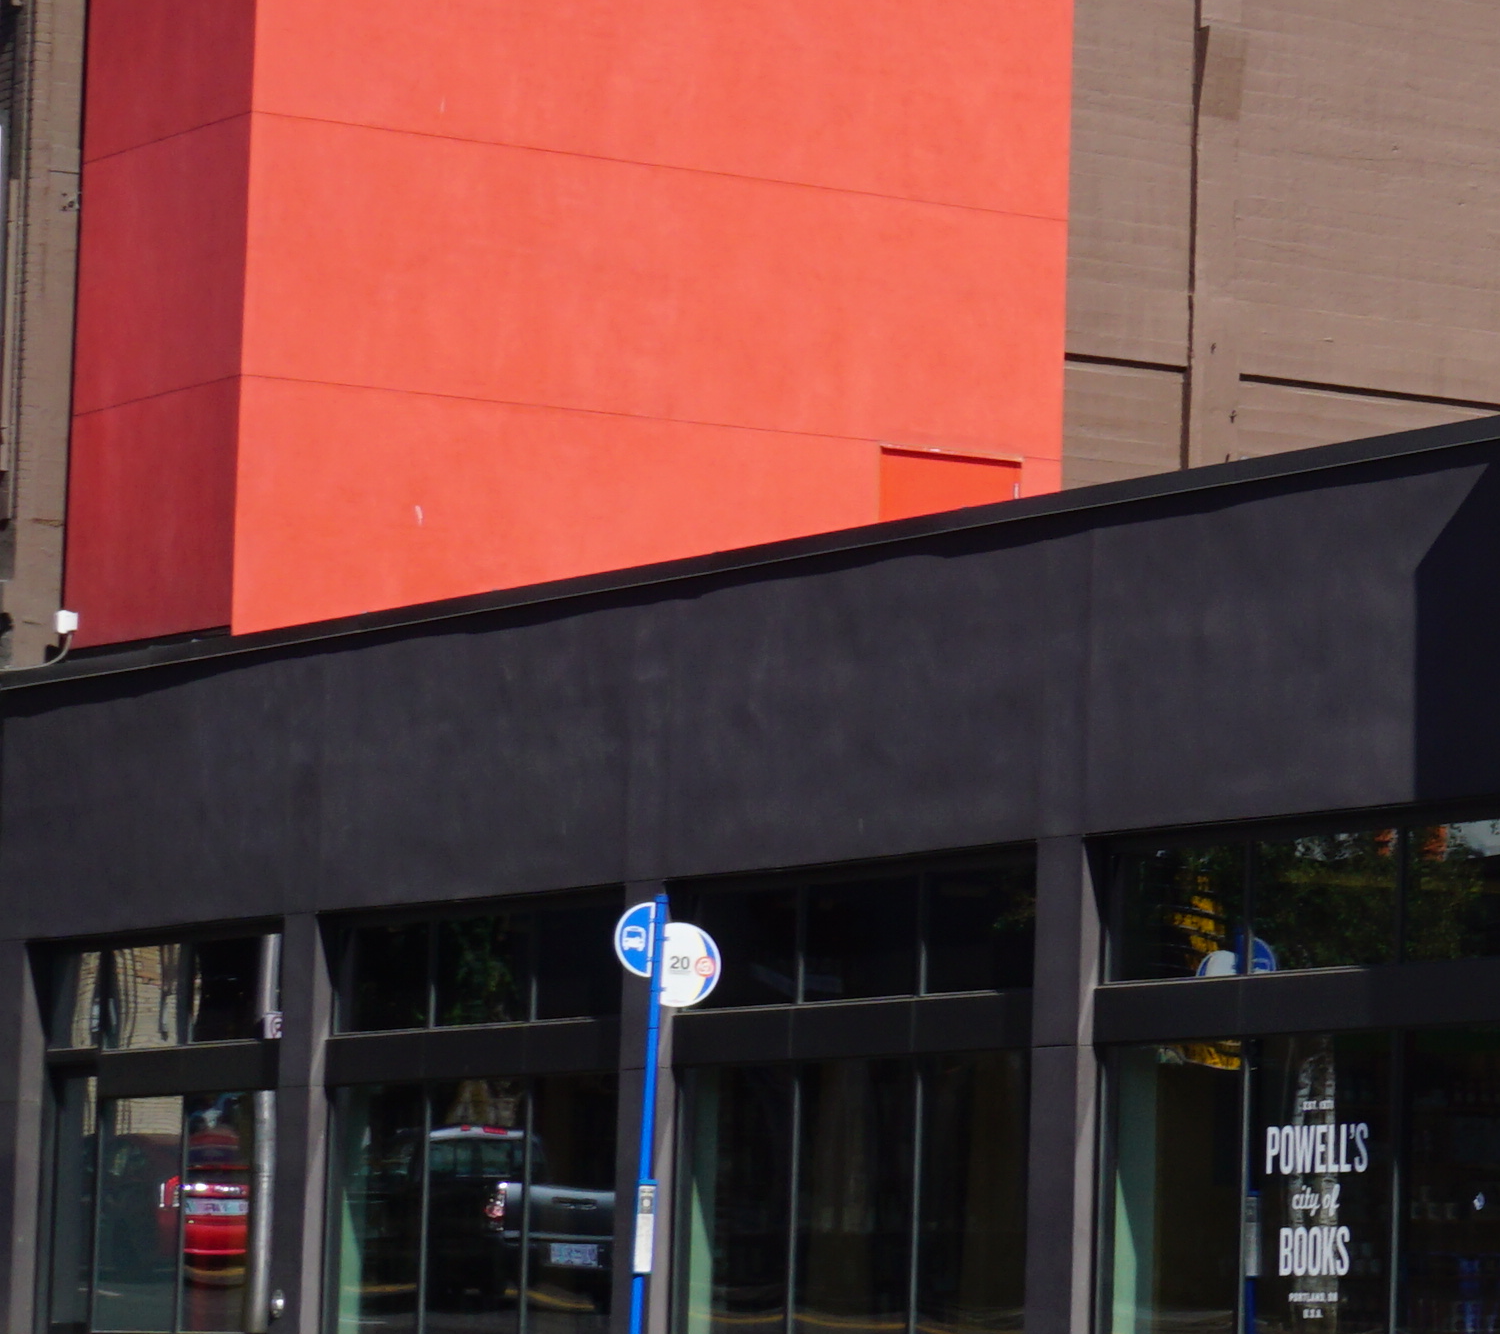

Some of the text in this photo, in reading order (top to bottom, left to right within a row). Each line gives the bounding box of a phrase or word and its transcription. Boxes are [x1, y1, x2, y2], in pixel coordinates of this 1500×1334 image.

[669, 955, 691, 970] 20
[1265, 1122, 1370, 1175] POWELL'S
[1291, 1183, 1341, 1216] city of
[1278, 1225, 1351, 1277] BOOKS
